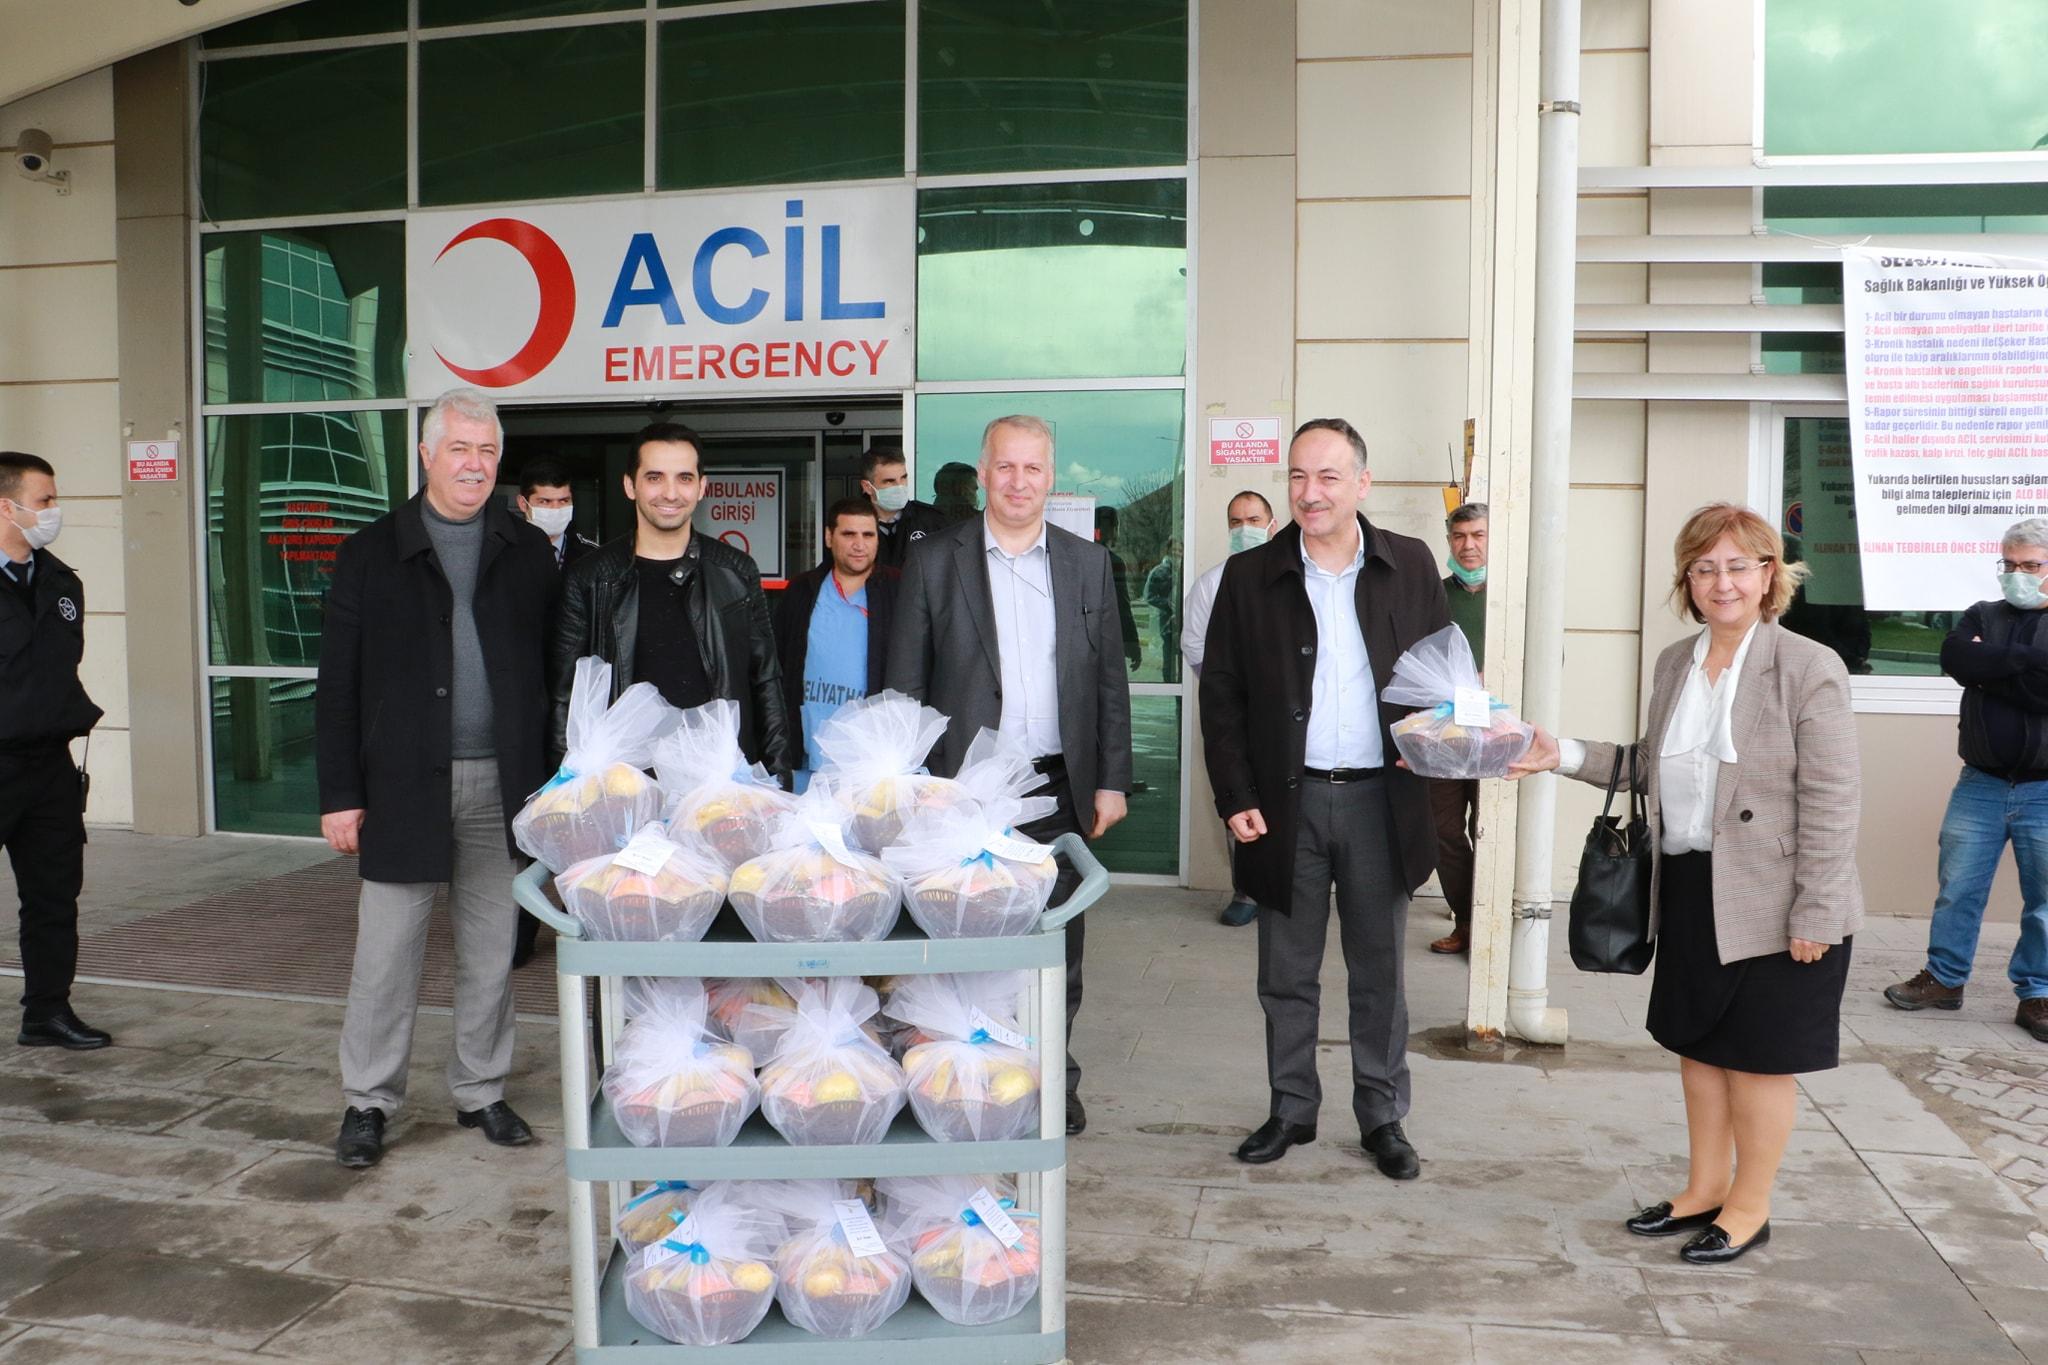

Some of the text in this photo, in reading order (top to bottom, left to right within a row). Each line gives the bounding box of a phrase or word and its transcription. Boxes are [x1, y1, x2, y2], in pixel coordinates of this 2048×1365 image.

[601, 199, 886, 329] ACİL
[1865, 279, 1904, 294] Sağlık
[1907, 277, 1967, 292] Bakanlığı
[1971, 278, 1985, 290] ve
[1989, 275, 2035, 289] Yüksek
[1909, 311, 1946, 321] durumu
[1949, 309, 1990, 321] olmayan
[605, 339, 890, 383] EMERGENCY
[1945, 367, 1956, 376] ve
[1941, 421, 1953, 431] Bu
[1996, 421, 2023, 431] rapor
[1868, 474, 1910, 485] Yukarıda
[1912, 474, 1959, 485] belirtilen
[1962, 474, 2010, 485] hususları
[704, 482, 776, 499] MBULANS
[1882, 489, 1904, 501] bilgi
[1906, 489, 1930, 500] alma
[1932, 489, 1991, 501] talepleriniz
[1993, 489, 2012, 502] için
[711, 501, 756, 525] GİRİŞİ
[1897, 504, 1946, 516] gelmeden
[1948, 504, 1971, 516] bilgi
[1973, 504, 2014, 515] almanız
[2016, 504, 2035, 517] için
[1896, 541, 1948, 554] TEDBİRLER
